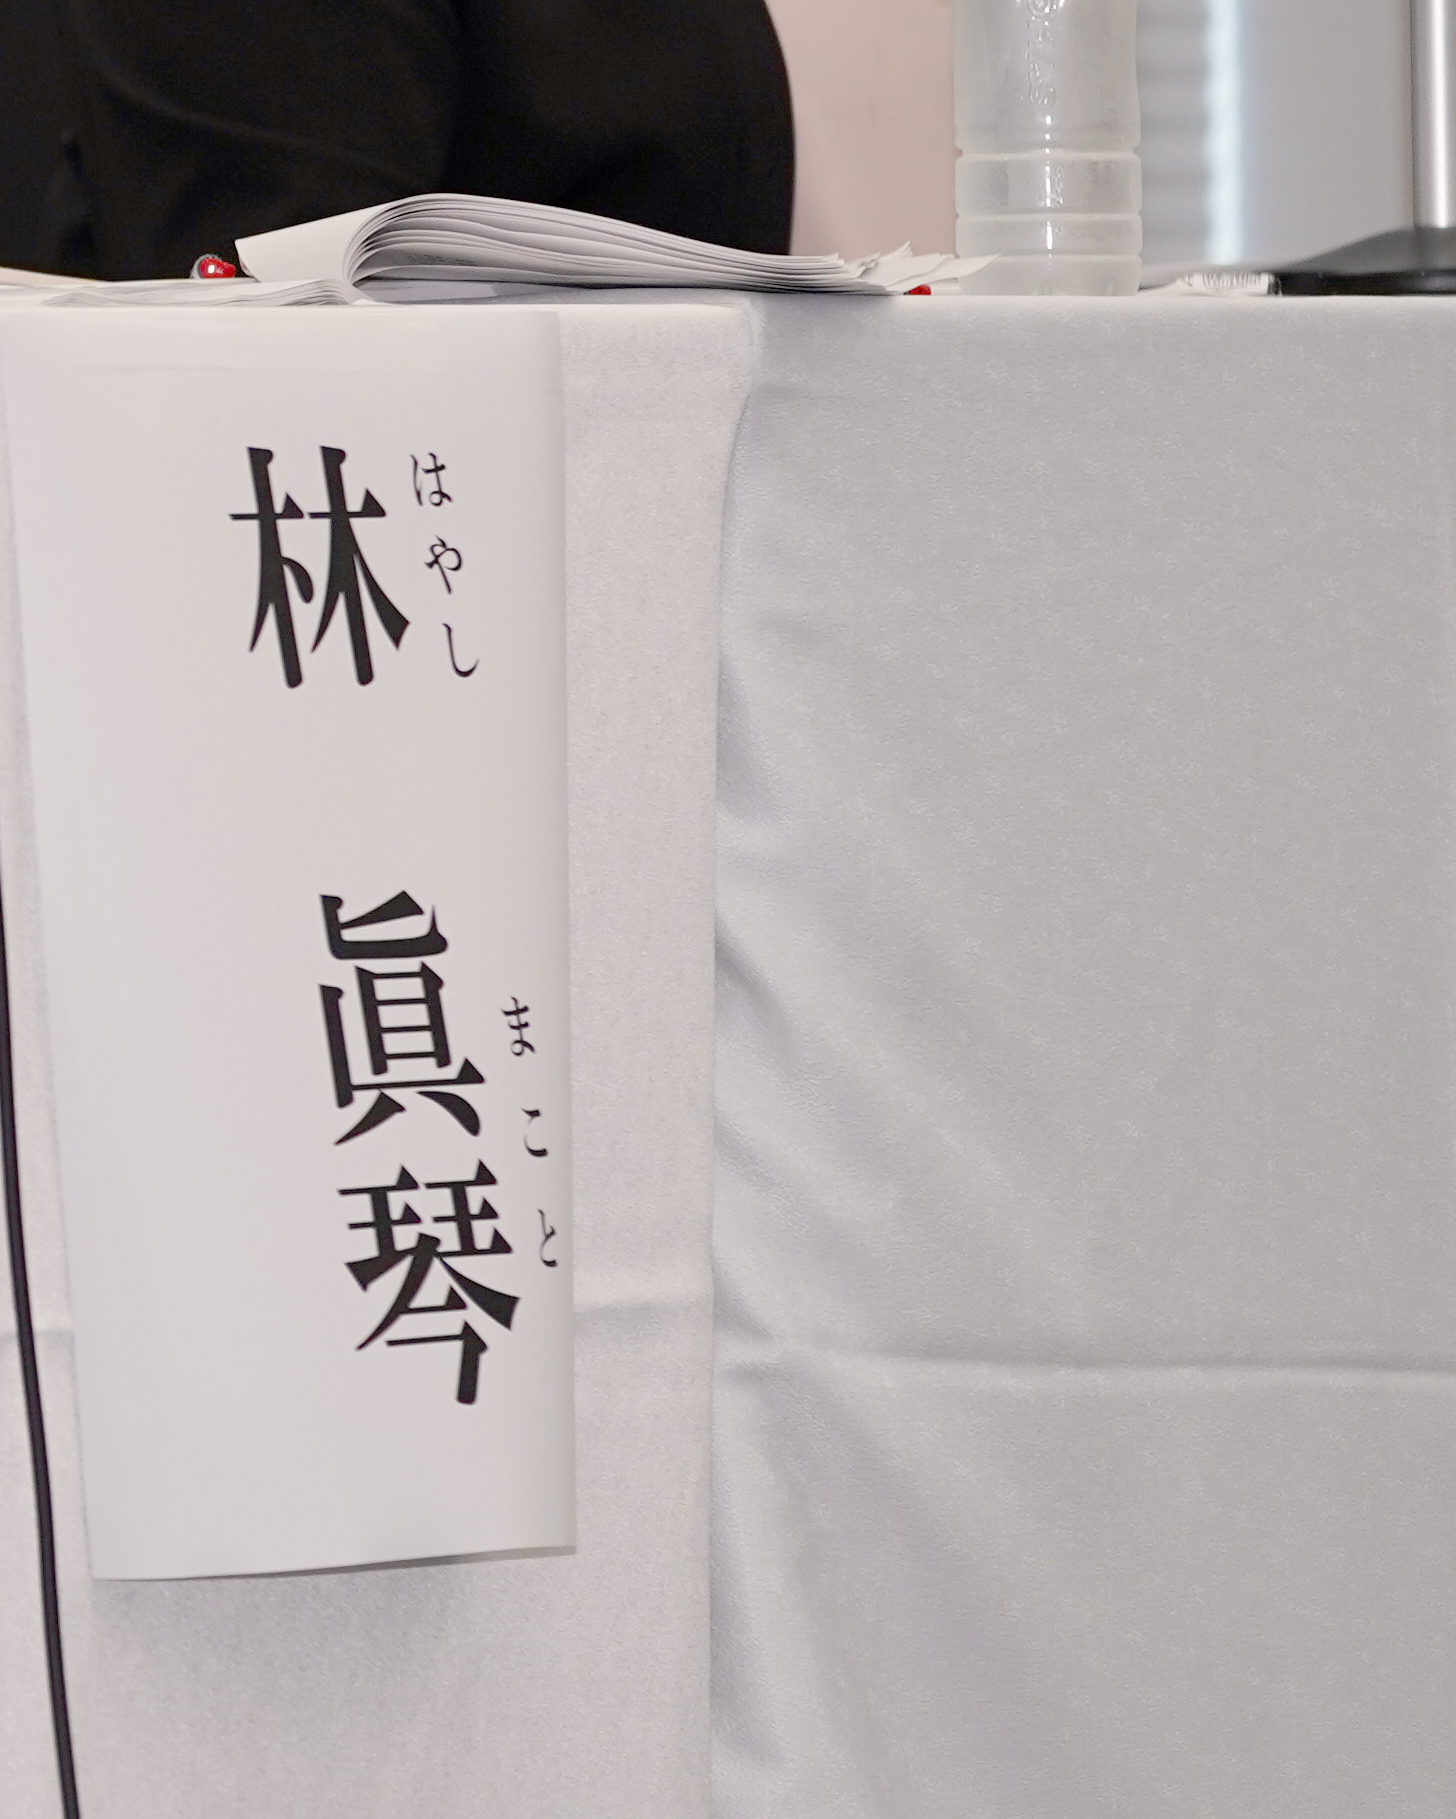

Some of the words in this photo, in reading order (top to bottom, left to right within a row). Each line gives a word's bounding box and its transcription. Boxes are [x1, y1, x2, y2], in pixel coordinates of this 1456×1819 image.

[229, 445, 411, 689] 林
[409, 451, 480, 679] はやし
[500, 995, 559, 1269] まこと
[317, 889, 521, 1406] 眞琴
